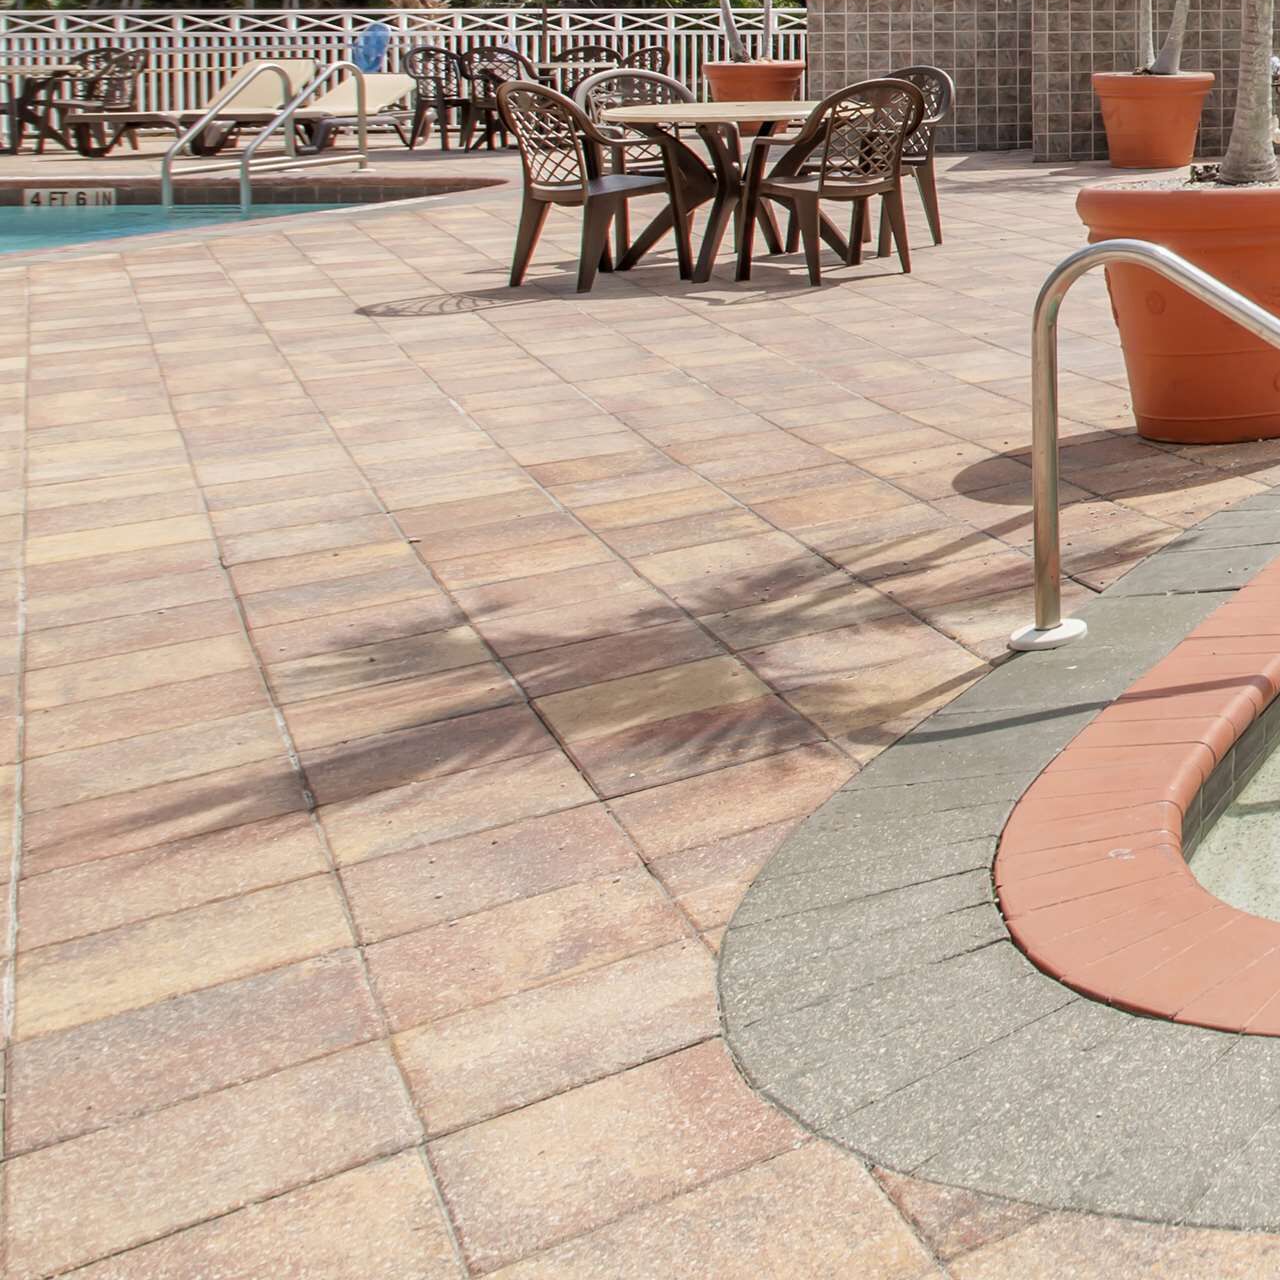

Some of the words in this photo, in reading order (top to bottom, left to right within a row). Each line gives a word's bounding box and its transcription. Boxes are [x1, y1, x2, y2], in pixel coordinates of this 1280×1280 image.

[30, 191, 42, 206] 4
[49, 191, 68, 206] FT
[75, 191, 87, 206] 6
[95, 191, 112, 206] IN
